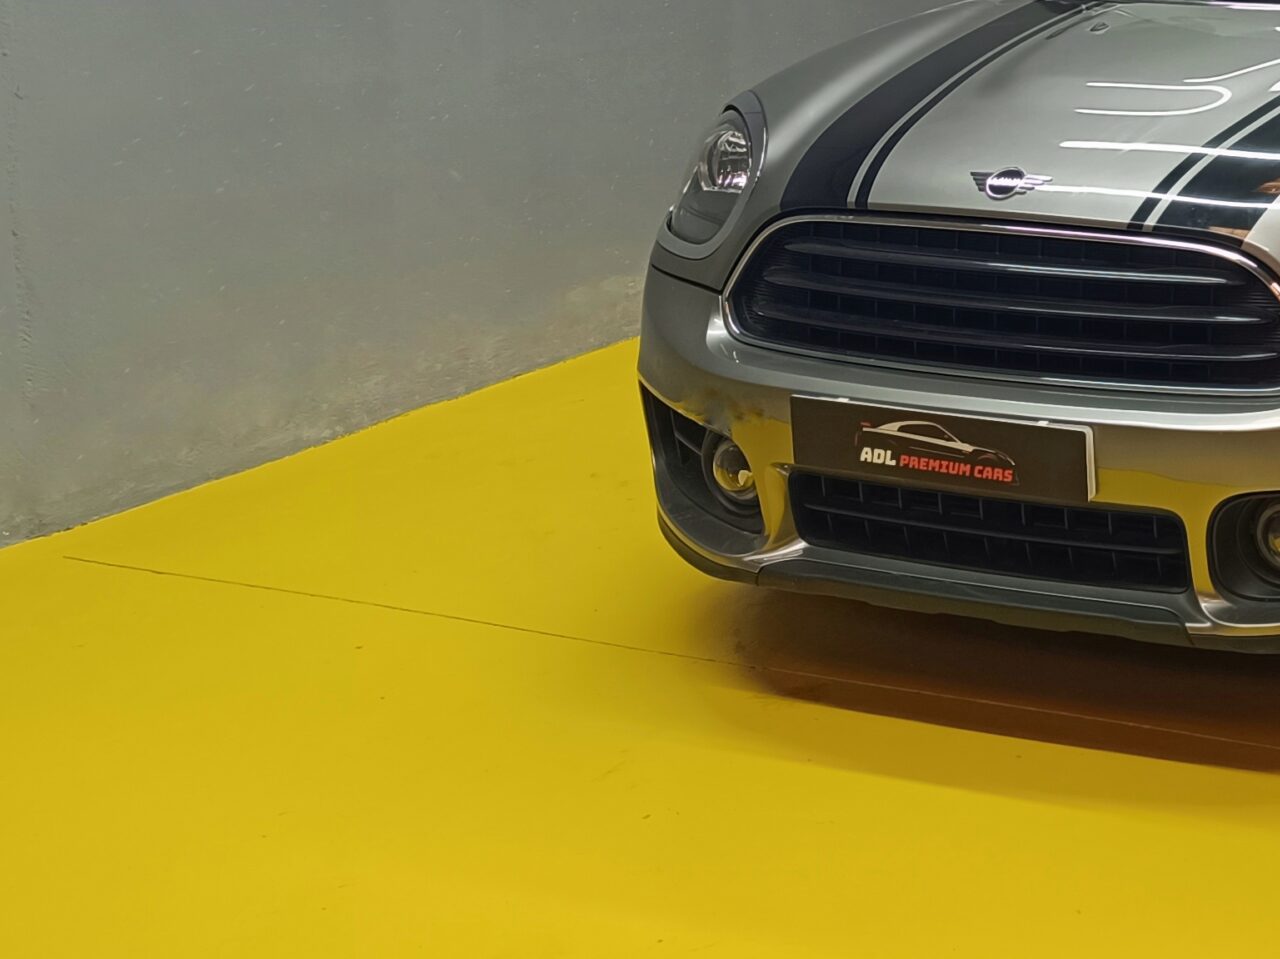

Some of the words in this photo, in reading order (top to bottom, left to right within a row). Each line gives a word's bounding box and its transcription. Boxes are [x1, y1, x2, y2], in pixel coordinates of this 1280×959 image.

[860, 447, 896, 465] ADL
[900, 455, 970, 476] PREMIUM
[974, 466, 1013, 482] CARS
